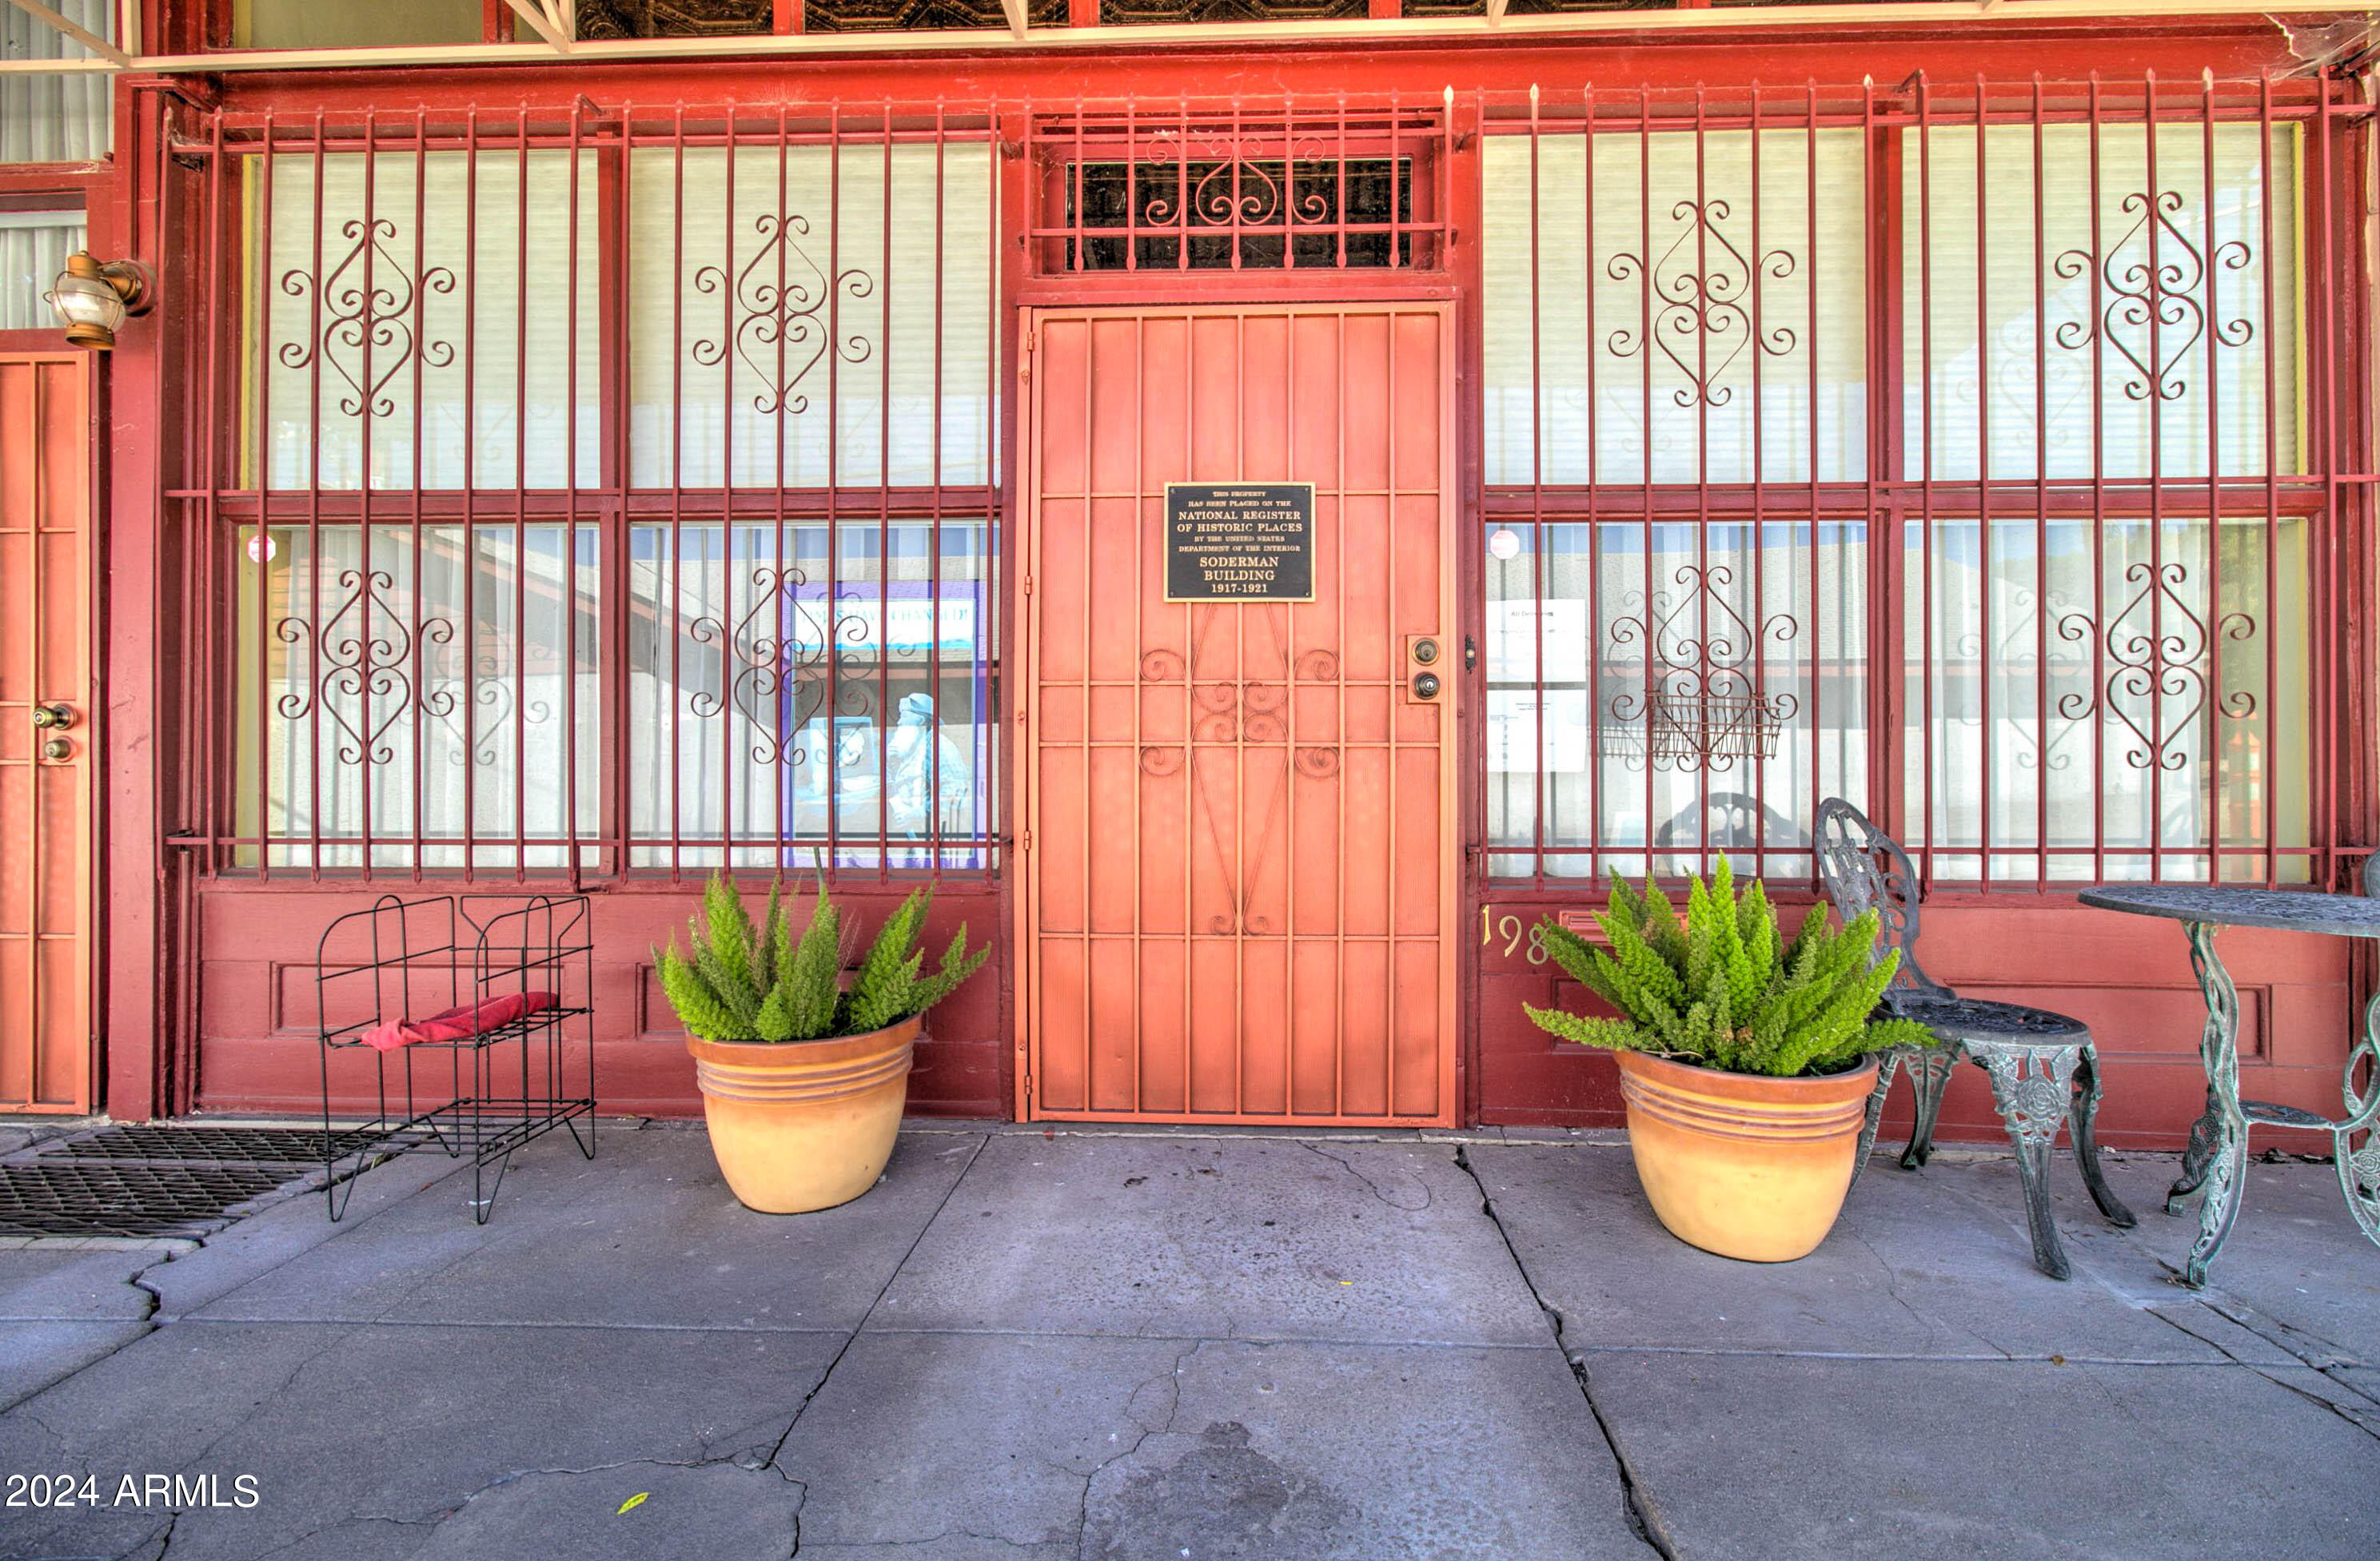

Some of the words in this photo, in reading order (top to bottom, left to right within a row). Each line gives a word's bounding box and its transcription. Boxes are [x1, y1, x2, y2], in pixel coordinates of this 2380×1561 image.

[1178, 511, 1238, 520] NATIONAL
[1242, 511, 1302, 520] REGISTER
[1177, 524, 1193, 532] OF
[1197, 524, 1253, 532] HISTORIC
[1258, 524, 1303, 532] PLACES
[1199, 556, 1280, 567] SODERMAN
[1204, 570, 1275, 581] BUILDING
[1211, 583, 1268, 593] 1917-1921
